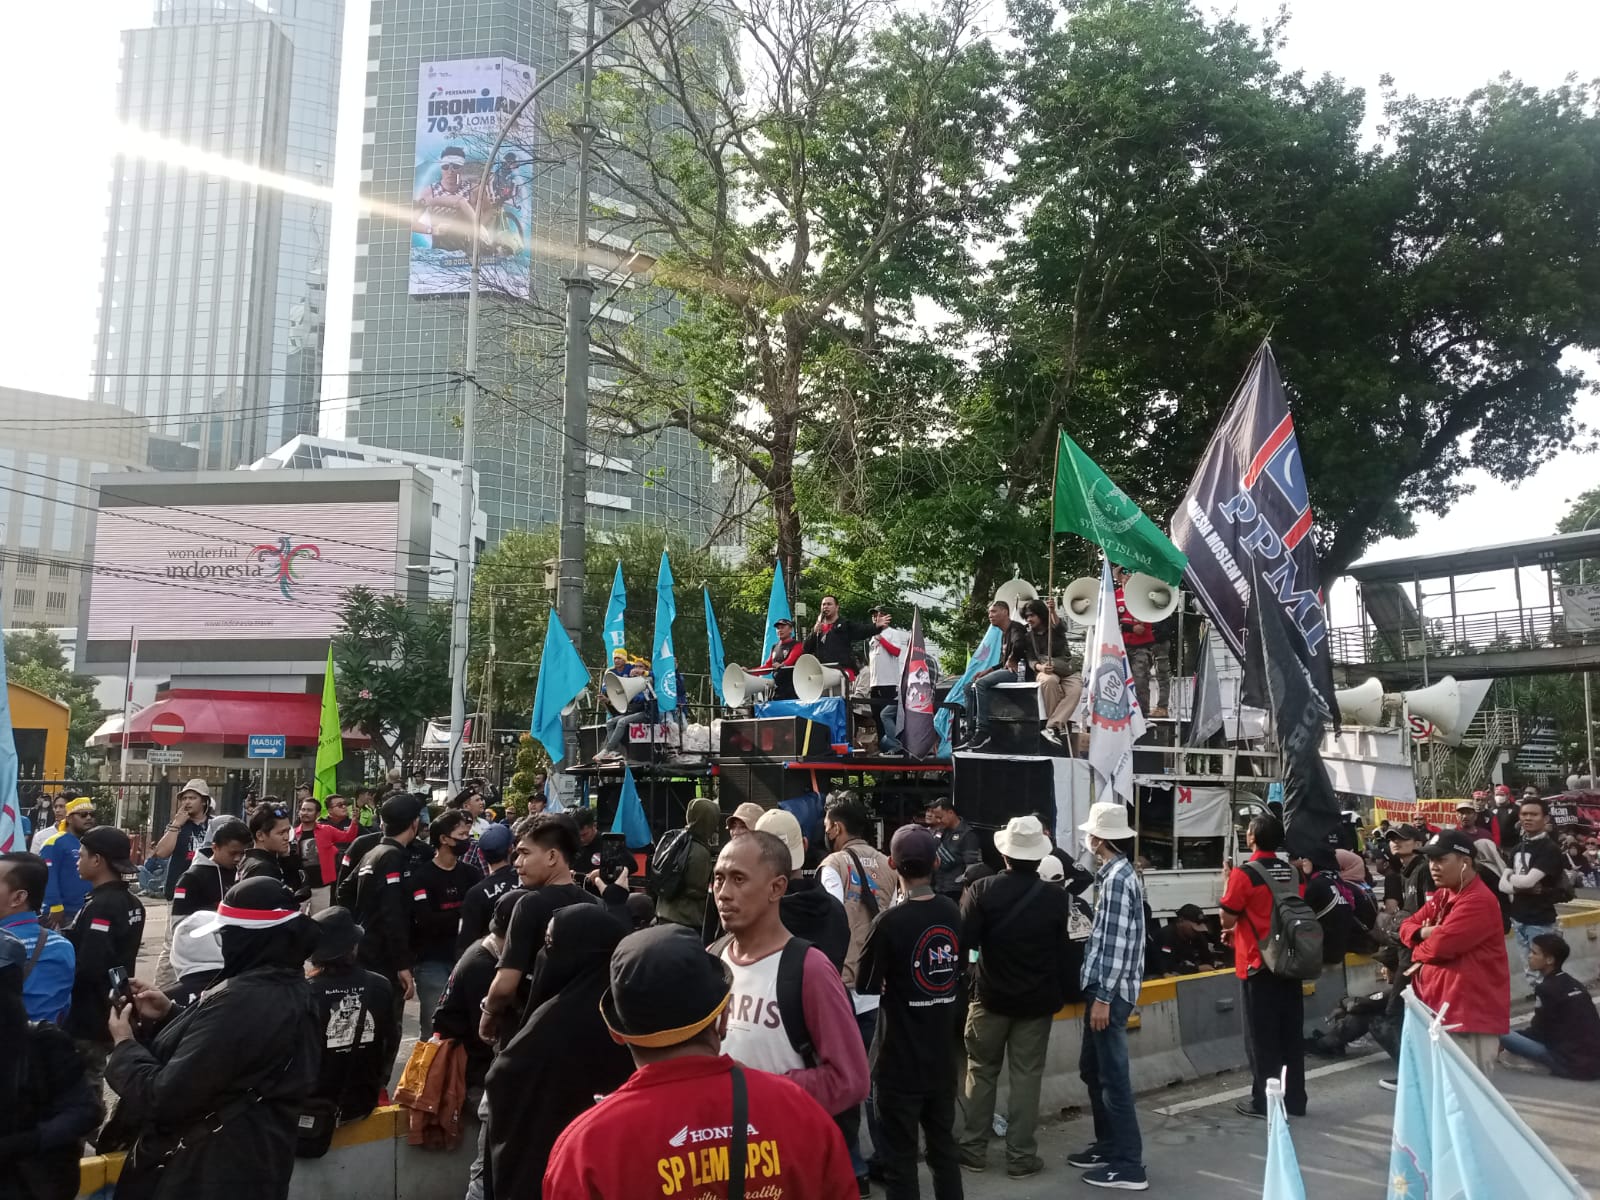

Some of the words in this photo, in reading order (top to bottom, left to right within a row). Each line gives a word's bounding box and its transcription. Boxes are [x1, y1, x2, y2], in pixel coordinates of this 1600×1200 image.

[428, 116, 463, 133] 70.3
[167, 546, 238, 560] wonderful
[1114, 542, 1152, 565] ISLAM
[1205, 531, 1241, 581] MOSLEM
[166, 560, 263, 578] indonesia
[1217, 489, 1326, 657] PPMI
[251, 738, 282, 746] MASUK
[1376, 799, 1416, 812] OMNIBUS
[725, 993, 780, 1029] ARIS
[657, 1156, 686, 1196] SP
[688, 1146, 730, 1187] LEM
[744, 1140, 781, 1180] PSI
